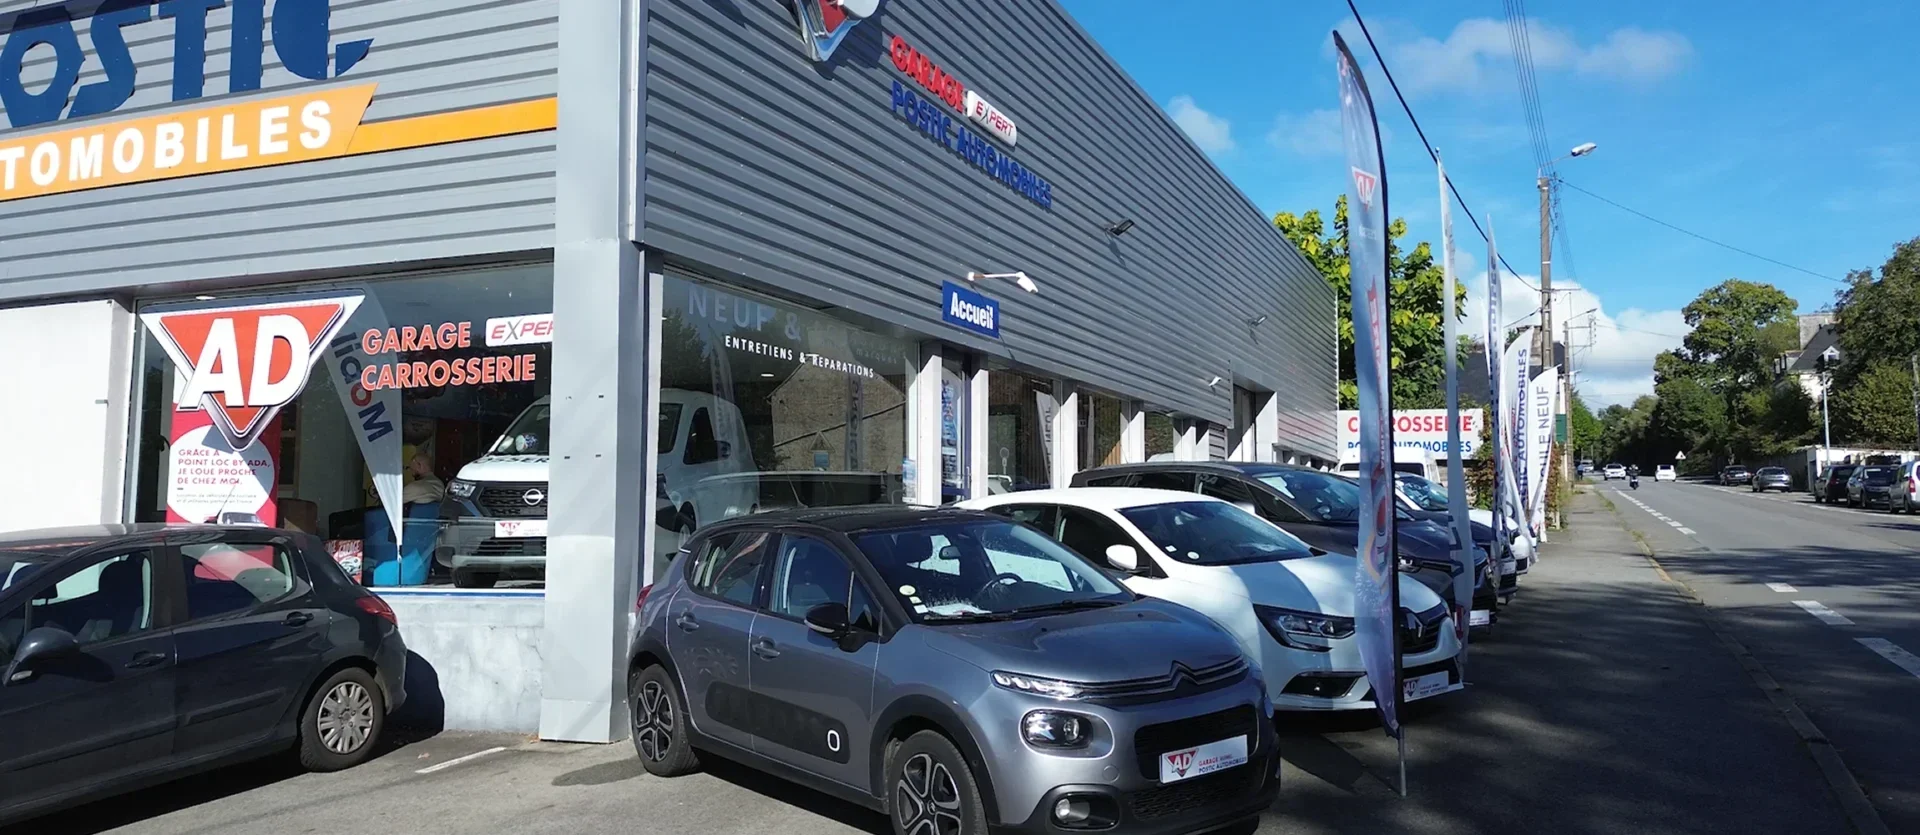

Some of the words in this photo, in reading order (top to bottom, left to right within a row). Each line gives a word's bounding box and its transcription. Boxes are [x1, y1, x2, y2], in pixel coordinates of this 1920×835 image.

[890, 35, 965, 114] GARAGE
[976, 100, 1014, 137] EXPERT
[891, 80, 952, 145] POSTIC
[956, 124, 1052, 208] AUTOMOBILES
[950, 291, 994, 330] Accueil
[362, 321, 472, 355] GARAGE
[725, 334, 794, 361] ENTRETIENS
[799, 352, 806, 364] &
[176, 313, 310, 410] AD
[360, 353, 537, 391] CARROSSERIE
[1536, 386, 1550, 429] NEUF
[178, 458, 208, 466] POINT
[232, 459, 243, 467] BY
[219, 468, 256, 476] PROCHE
[177, 477, 188, 485] DE
[192, 477, 216, 485] CHEZ
[1173, 753, 1193, 771] AD
[1198, 757, 1218, 767] GARAGE
